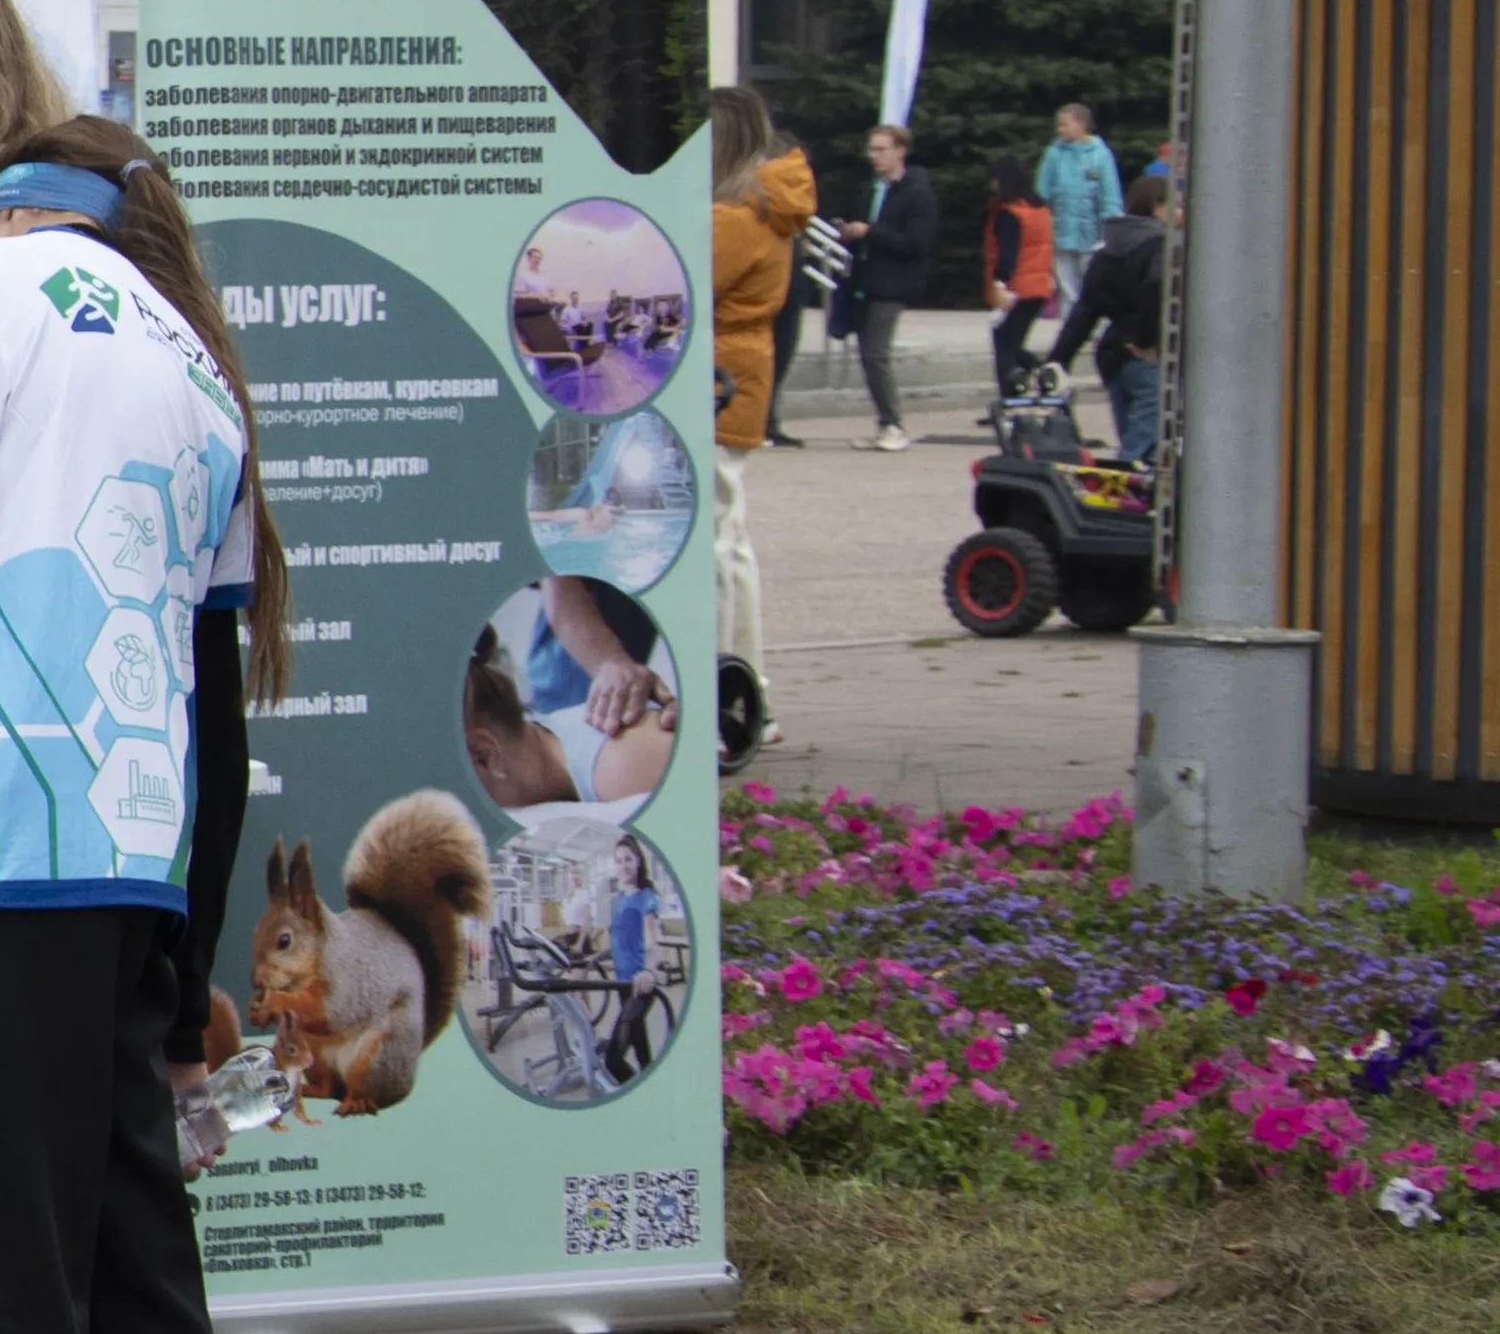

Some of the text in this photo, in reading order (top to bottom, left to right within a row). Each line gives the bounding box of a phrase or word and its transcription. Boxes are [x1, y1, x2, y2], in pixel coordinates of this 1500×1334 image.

[146, 36, 464, 68] ОСНОВНЫЕ НАПРАВЛЕНИЯ:
[146, 83, 547, 107] заболевания опорно-двигательного аппарата
[146, 115, 556, 138] заболевания органов дыхания и пищеварения
[157, 142, 542, 168] аболевания нервной и эндокринной систем
[172, 173, 542, 200] болевания сердечно-сосудистой системы
[282, 383, 300, 401] по
[303, 378, 392, 402] путёвкам,
[395, 378, 499, 401] курсовкам
[385, 403, 464, 424] лечение)
[303, 456, 353, 477] «Мать
[356, 458, 367, 476] и
[371, 455, 428, 479] дитя»
[315, 546, 326, 565] и
[329, 537, 446, 566] спортивный
[449, 540, 502, 565] досуг
[318, 620, 352, 641] зал
[333, 694, 368, 715] зал
